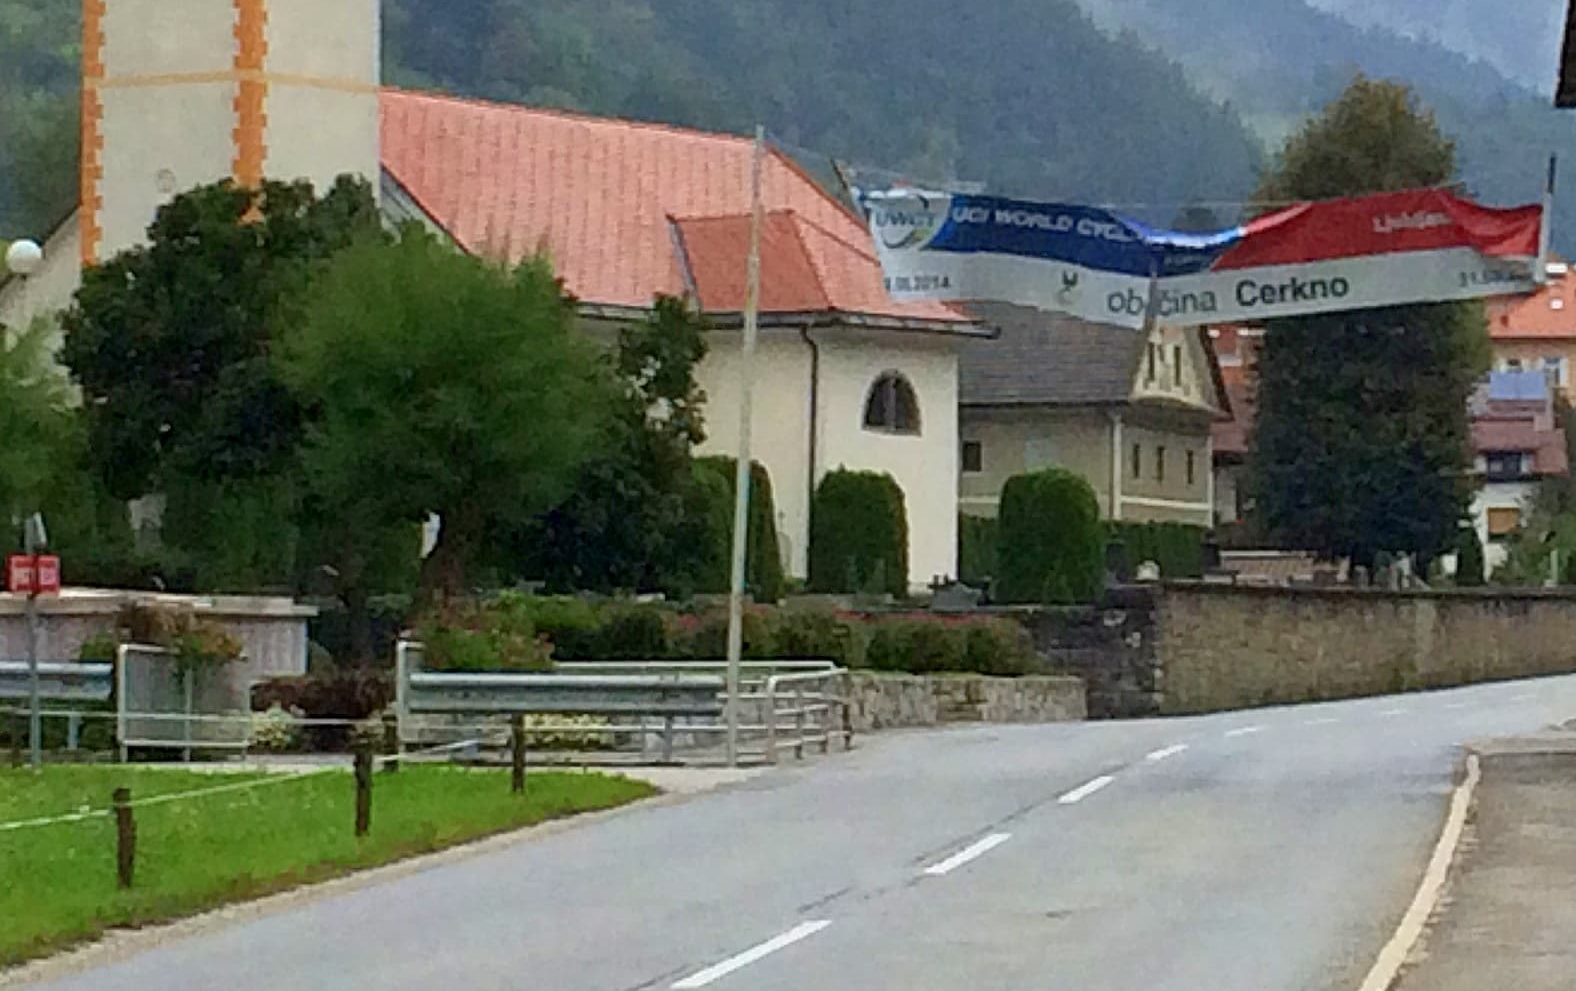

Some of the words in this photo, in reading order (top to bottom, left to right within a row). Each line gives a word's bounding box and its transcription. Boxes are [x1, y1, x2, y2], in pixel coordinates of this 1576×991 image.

[952, 206, 990, 223] UCI
[995, 209, 1074, 232] WORLD
[1235, 274, 1350, 308] Cerkno
